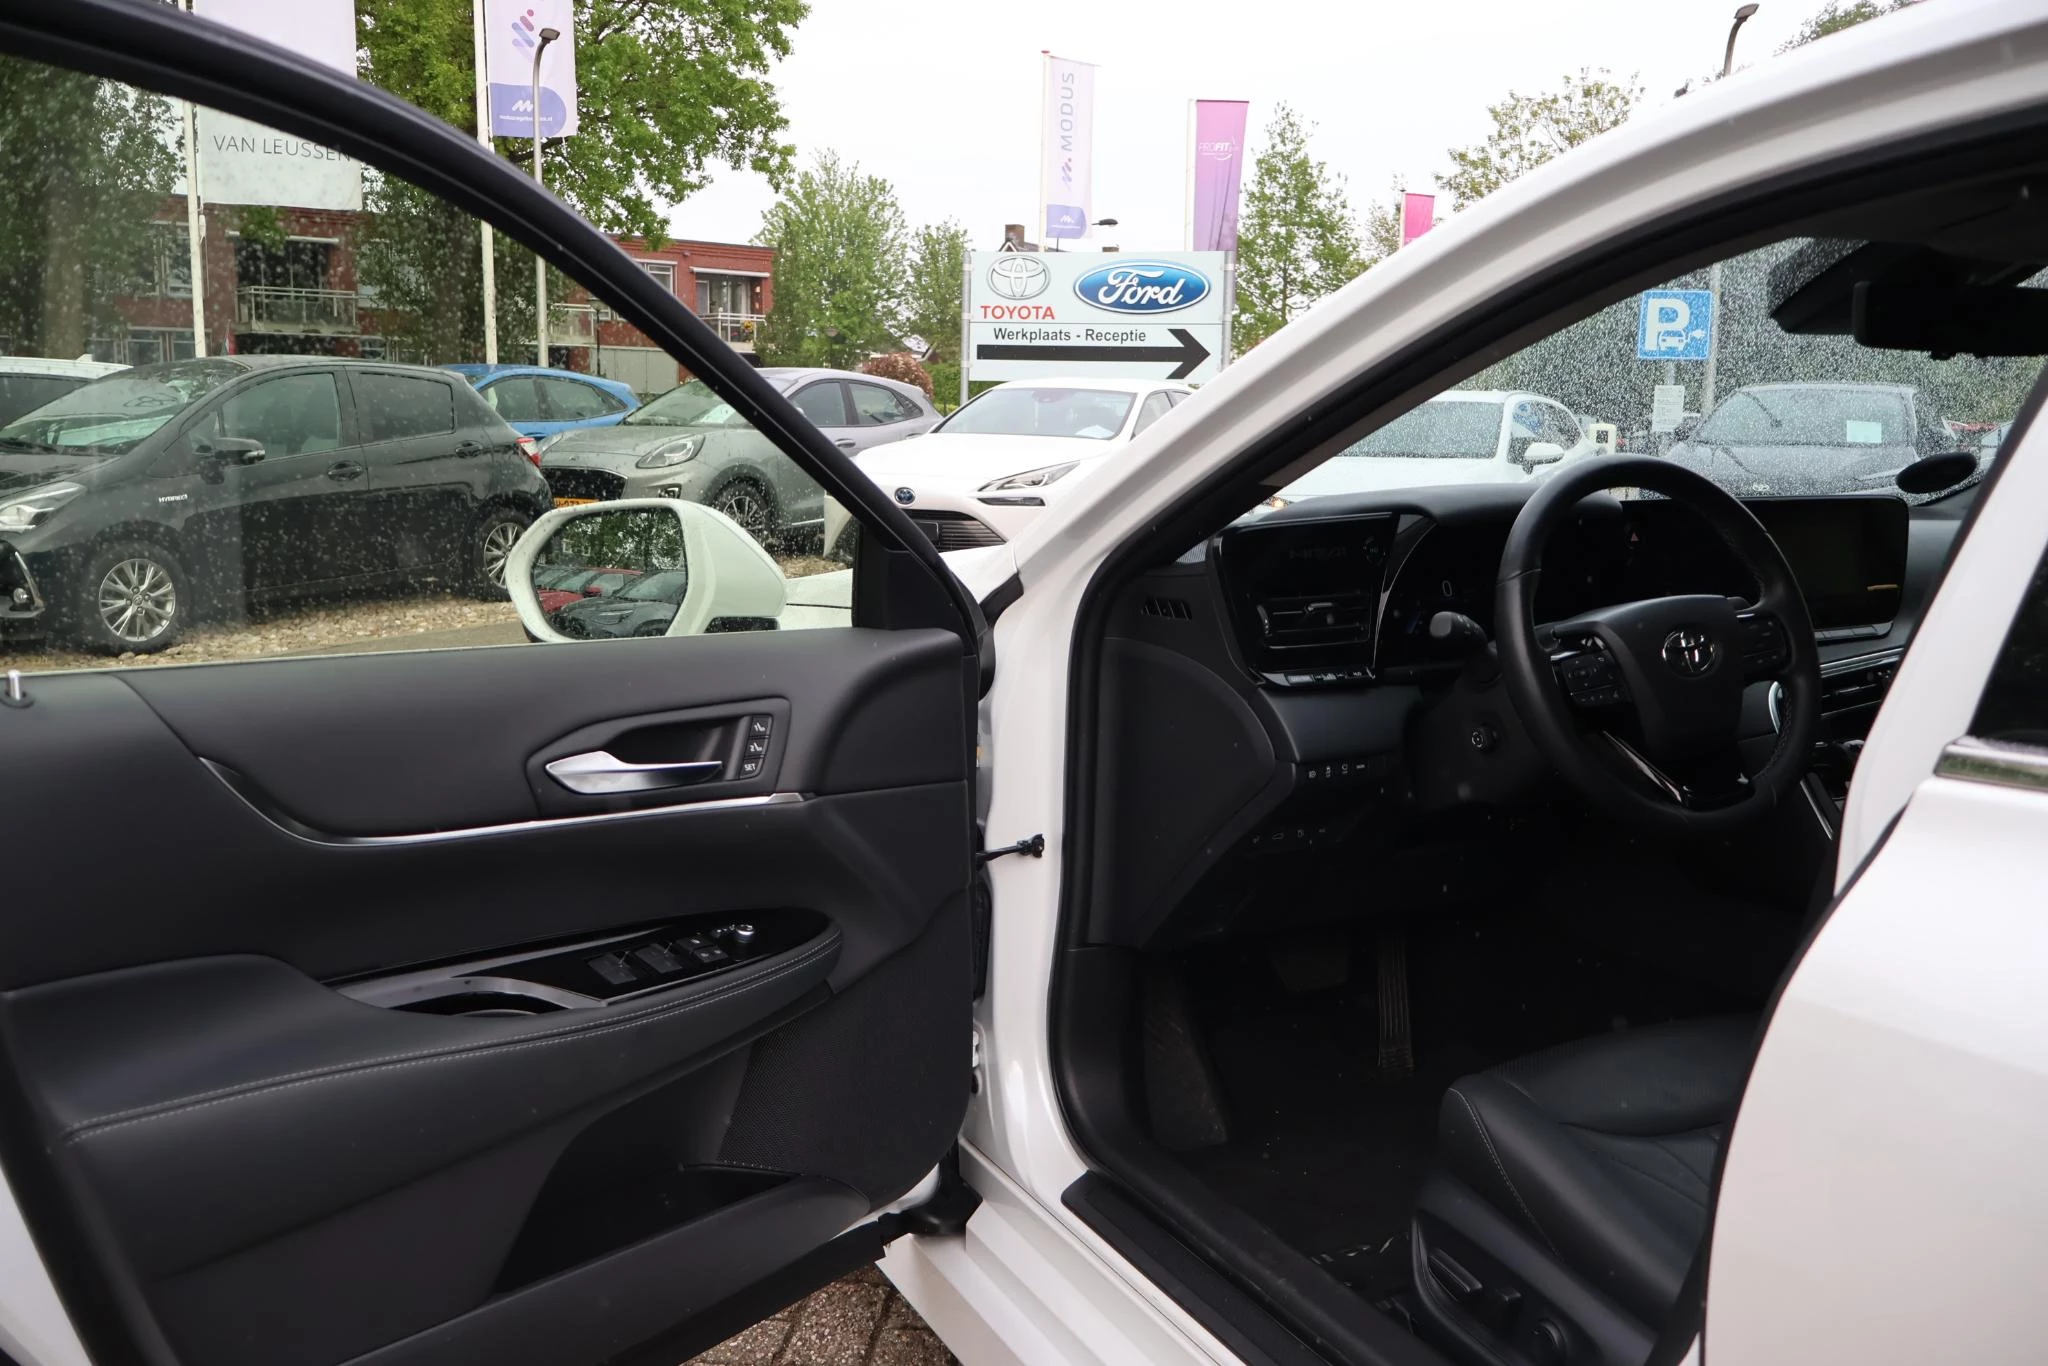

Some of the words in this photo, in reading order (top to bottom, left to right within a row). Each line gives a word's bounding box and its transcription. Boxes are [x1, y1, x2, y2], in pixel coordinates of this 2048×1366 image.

[1060, 72, 1075, 152] MODUS
[213, 135, 255, 153] VAN
[1099, 270, 1183, 306] Ford
[980, 305, 1055, 320] TOYOTA
[1646, 298, 1690, 350] P
[993, 327, 1071, 343] Werkplaats
[1085, 328, 1146, 344] Receptie
